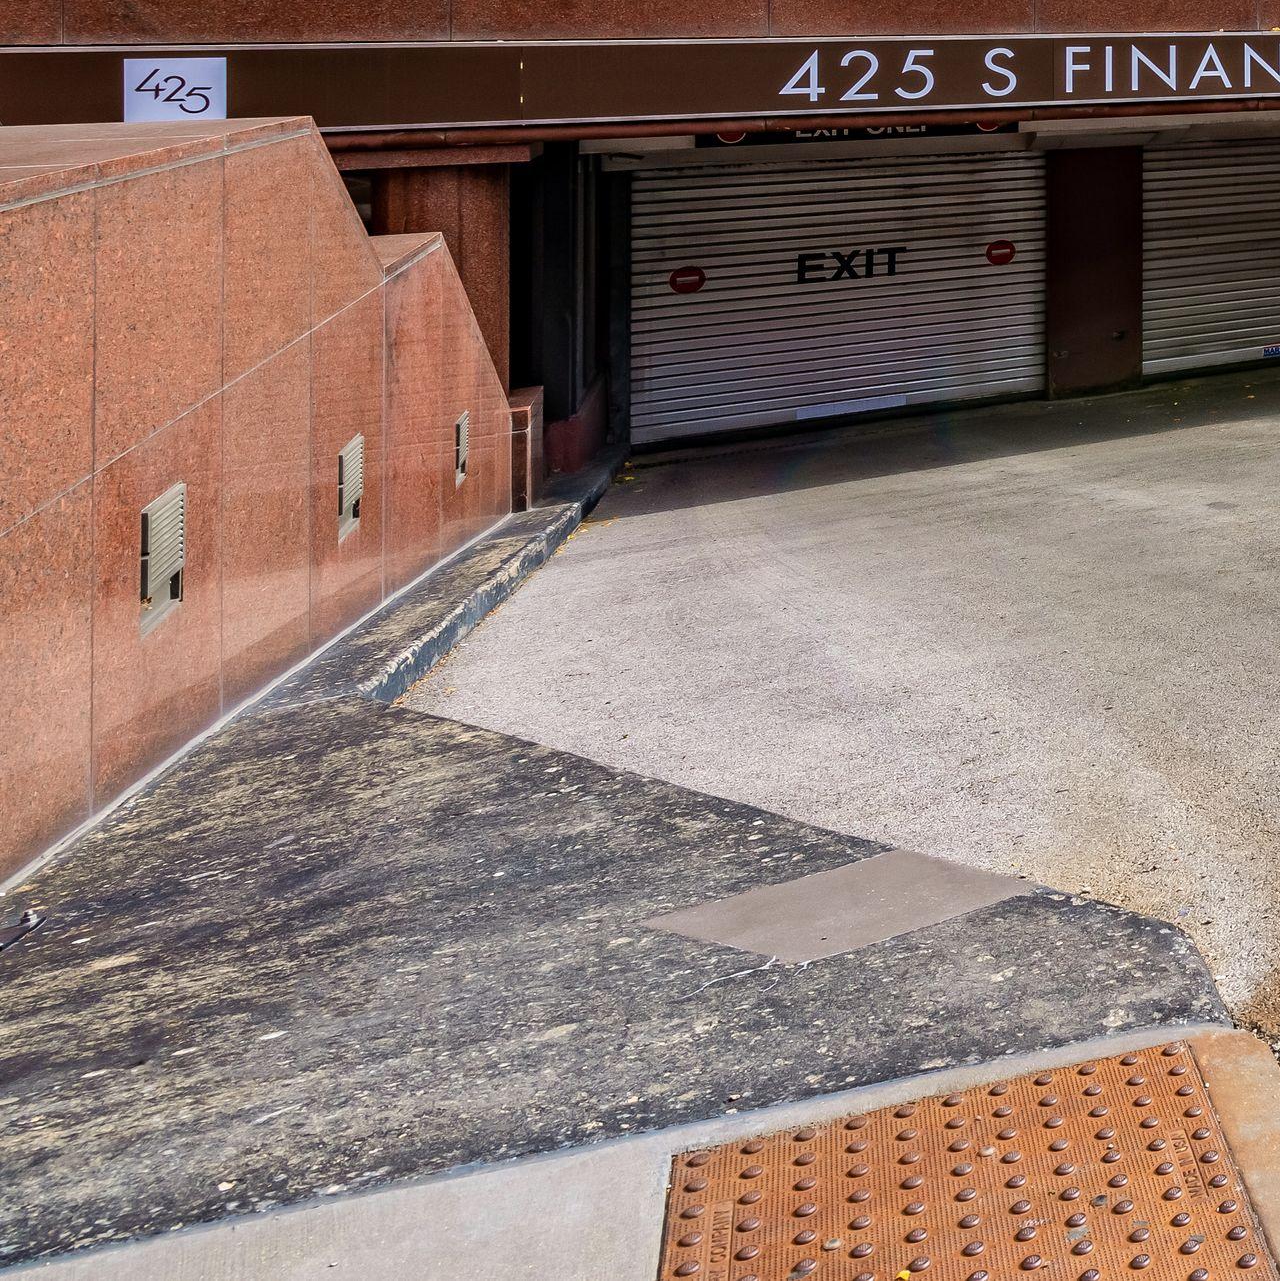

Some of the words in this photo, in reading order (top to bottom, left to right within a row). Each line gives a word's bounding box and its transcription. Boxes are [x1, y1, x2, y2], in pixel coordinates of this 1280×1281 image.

[134, 68, 213, 114] 425
[778, 48, 936, 102] 425
[981, 47, 1018, 97] S
[797, 246, 907, 285] EXIT
[710, 1210, 730, 1263] COMPANY
